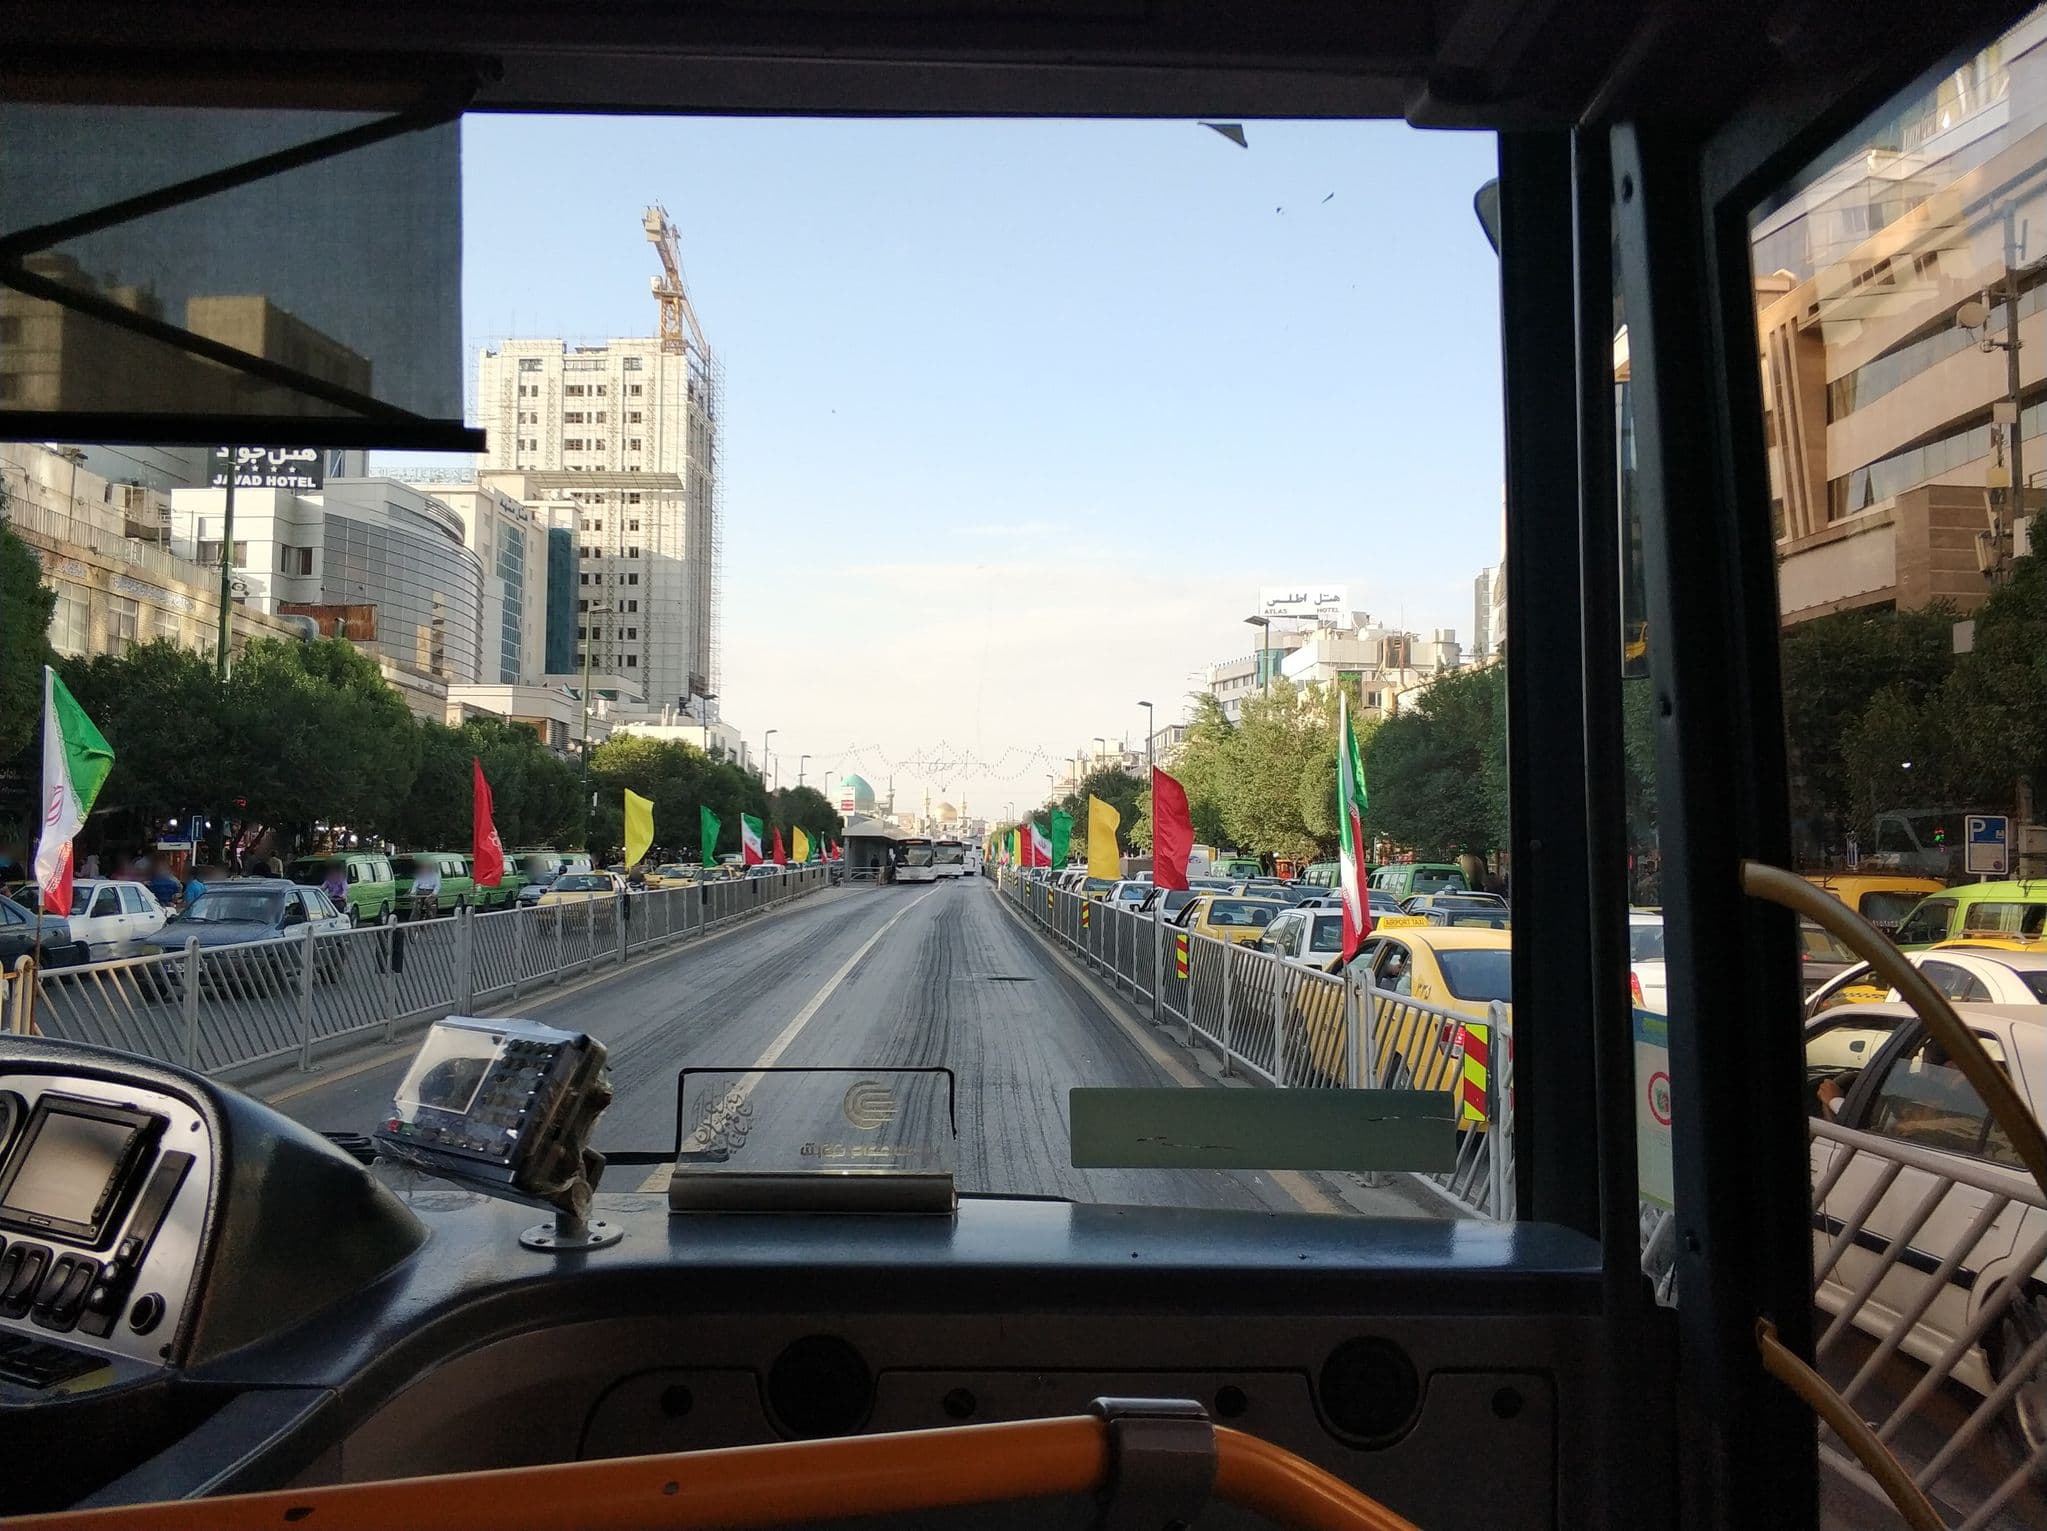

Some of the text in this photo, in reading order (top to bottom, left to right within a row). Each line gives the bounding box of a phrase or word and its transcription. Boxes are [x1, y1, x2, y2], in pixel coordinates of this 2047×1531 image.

[216, 447, 266, 464] جود
[266, 475, 316, 488] HOTEL
[1266, 593, 1341, 607] هتل اطلس
[1970, 819, 1986, 841] P
